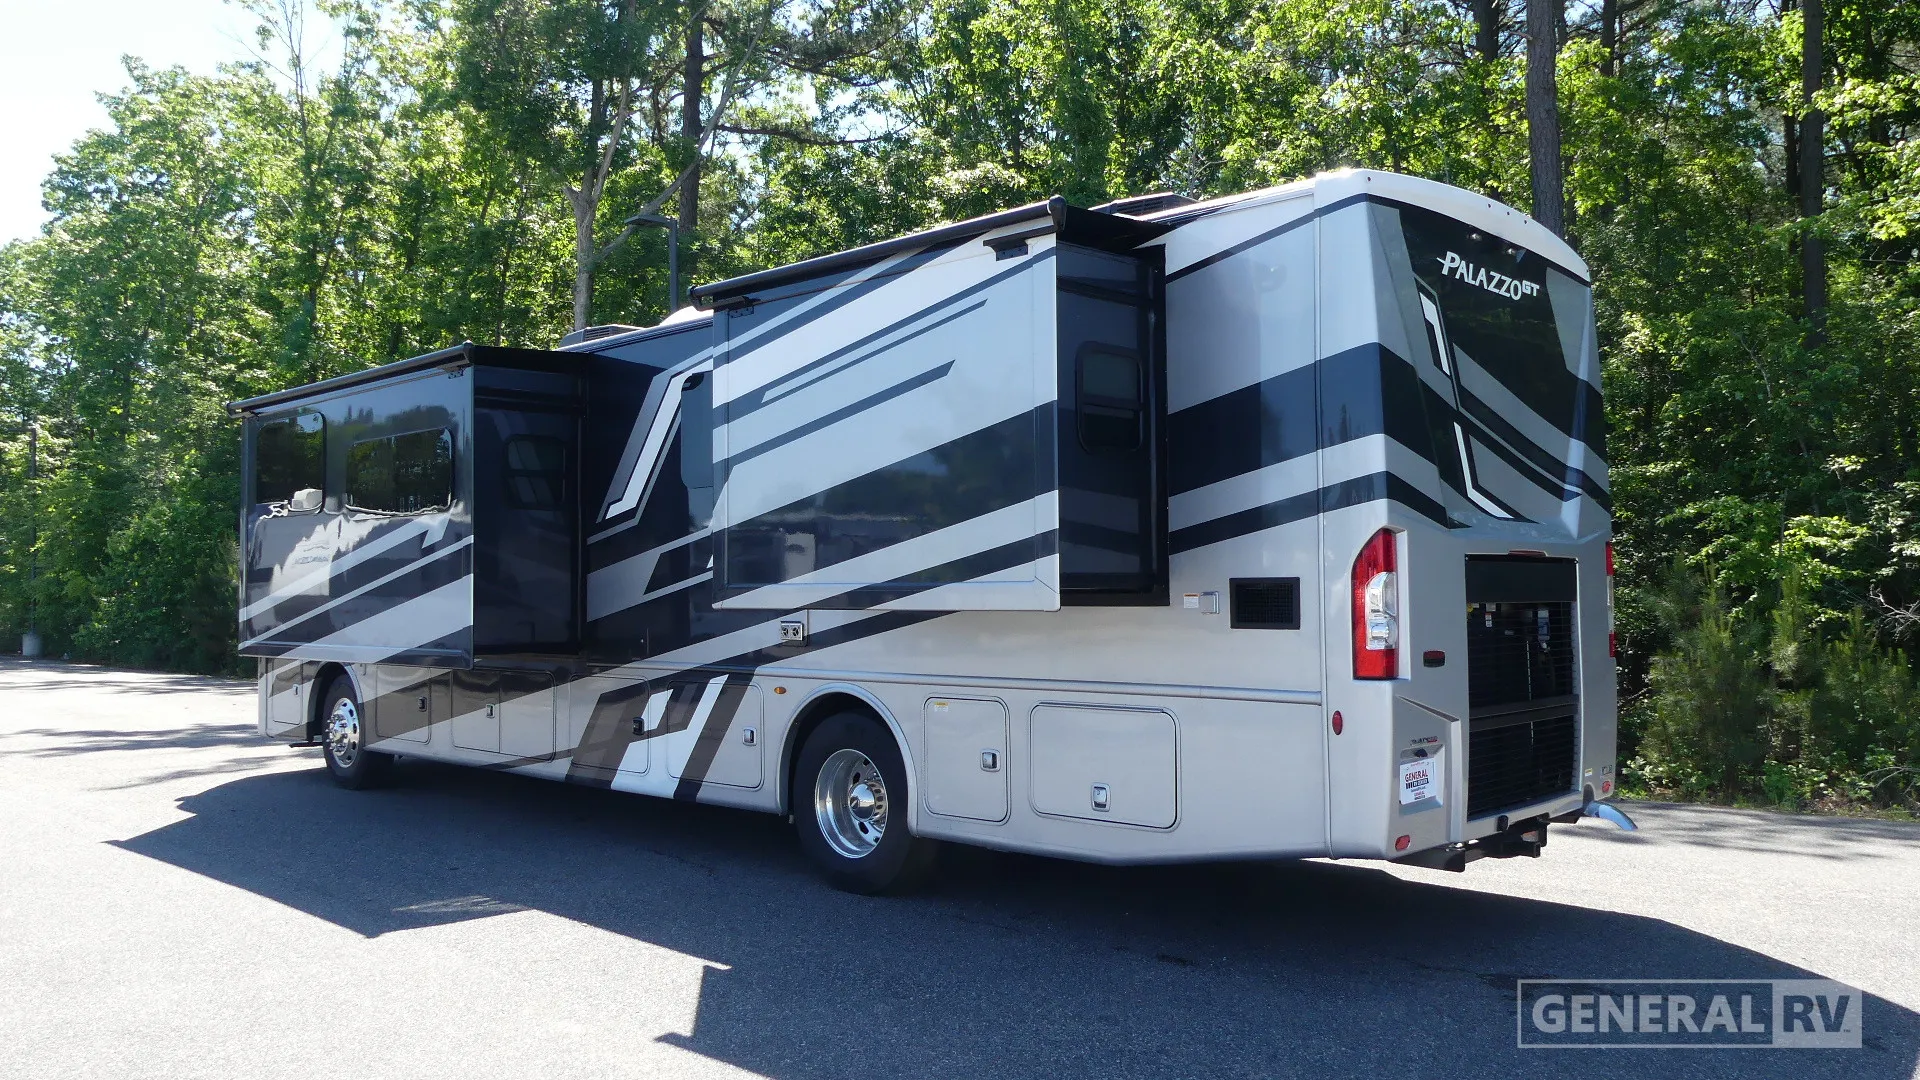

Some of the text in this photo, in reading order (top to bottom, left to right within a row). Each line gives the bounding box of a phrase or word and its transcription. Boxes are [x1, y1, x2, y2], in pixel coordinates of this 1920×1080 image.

[1436, 251, 1540, 301] PALAZZO GT
[1405, 769, 1428, 782] GENERAL
